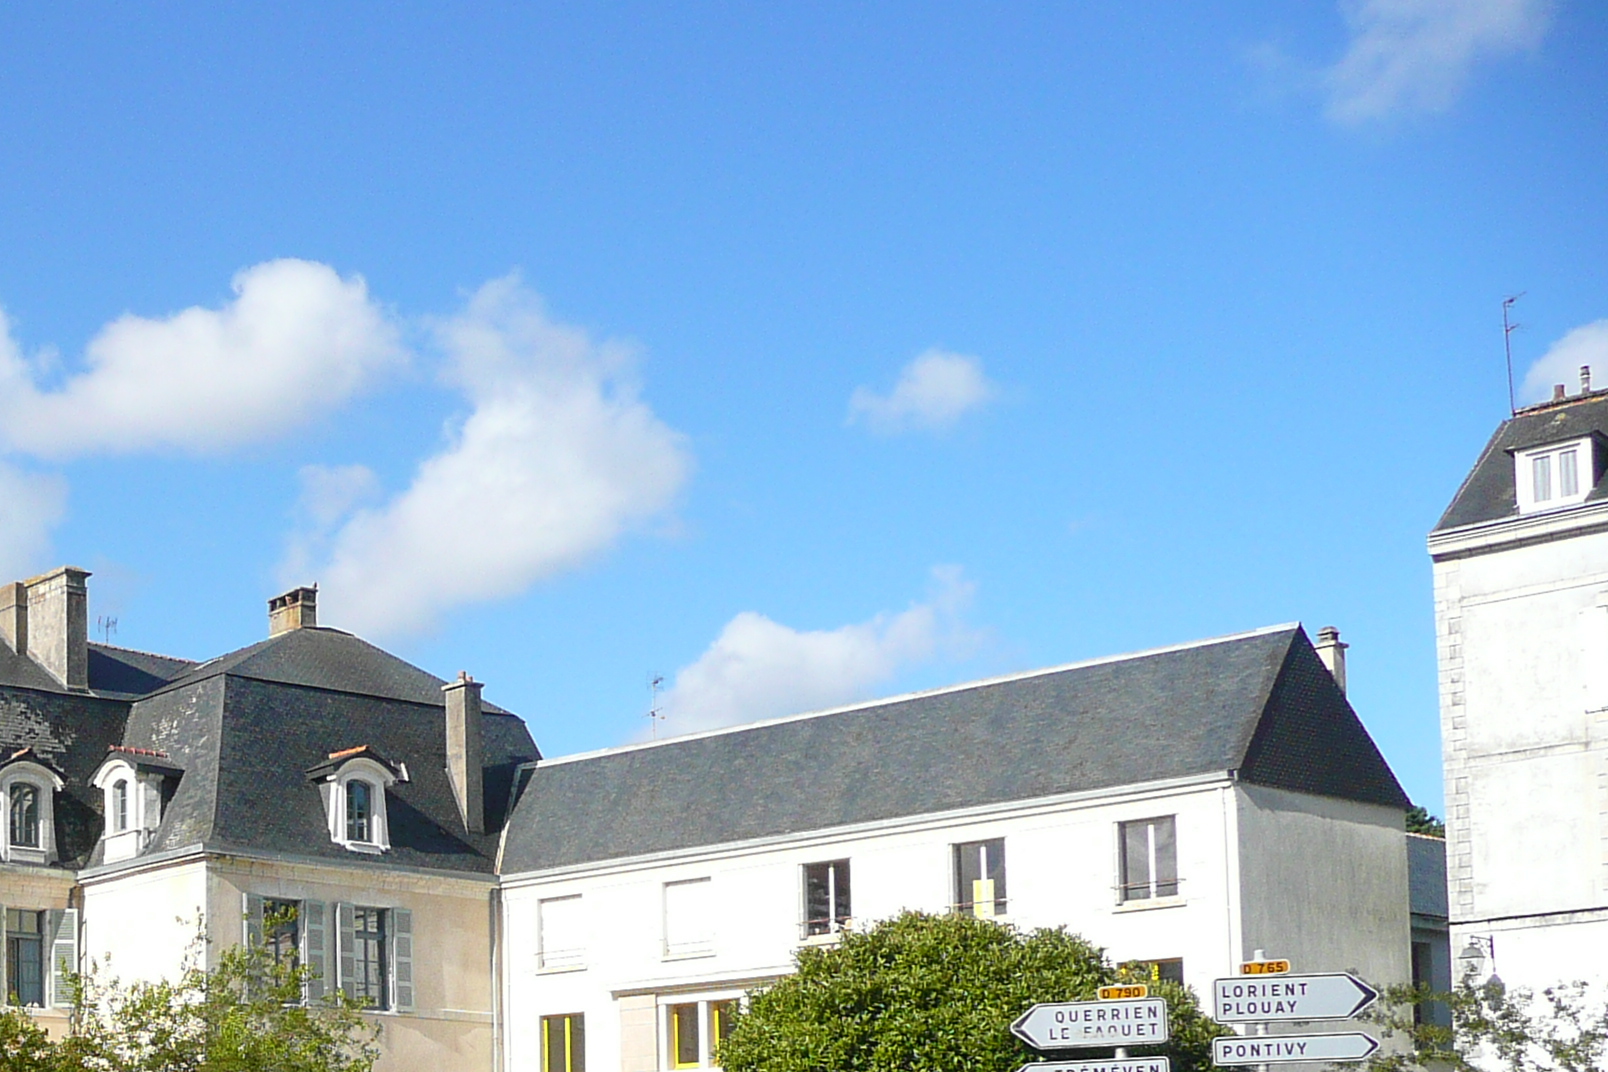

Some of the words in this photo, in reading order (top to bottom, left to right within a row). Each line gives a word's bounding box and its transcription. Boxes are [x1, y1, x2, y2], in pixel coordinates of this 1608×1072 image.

[1244, 965, 1251, 974] D
[1259, 962, 1283, 974] 765
[1102, 989, 1110, 999] D
[1117, 987, 1141, 998] 790
[1222, 983, 1308, 998] LORIENT
[1055, 1006, 1158, 1023] QUERRIEN
[1223, 1001, 1297, 1015] PLOUAY
[1049, 1028, 1070, 1040] LE
[1223, 1042, 1307, 1058] PONTIVY
